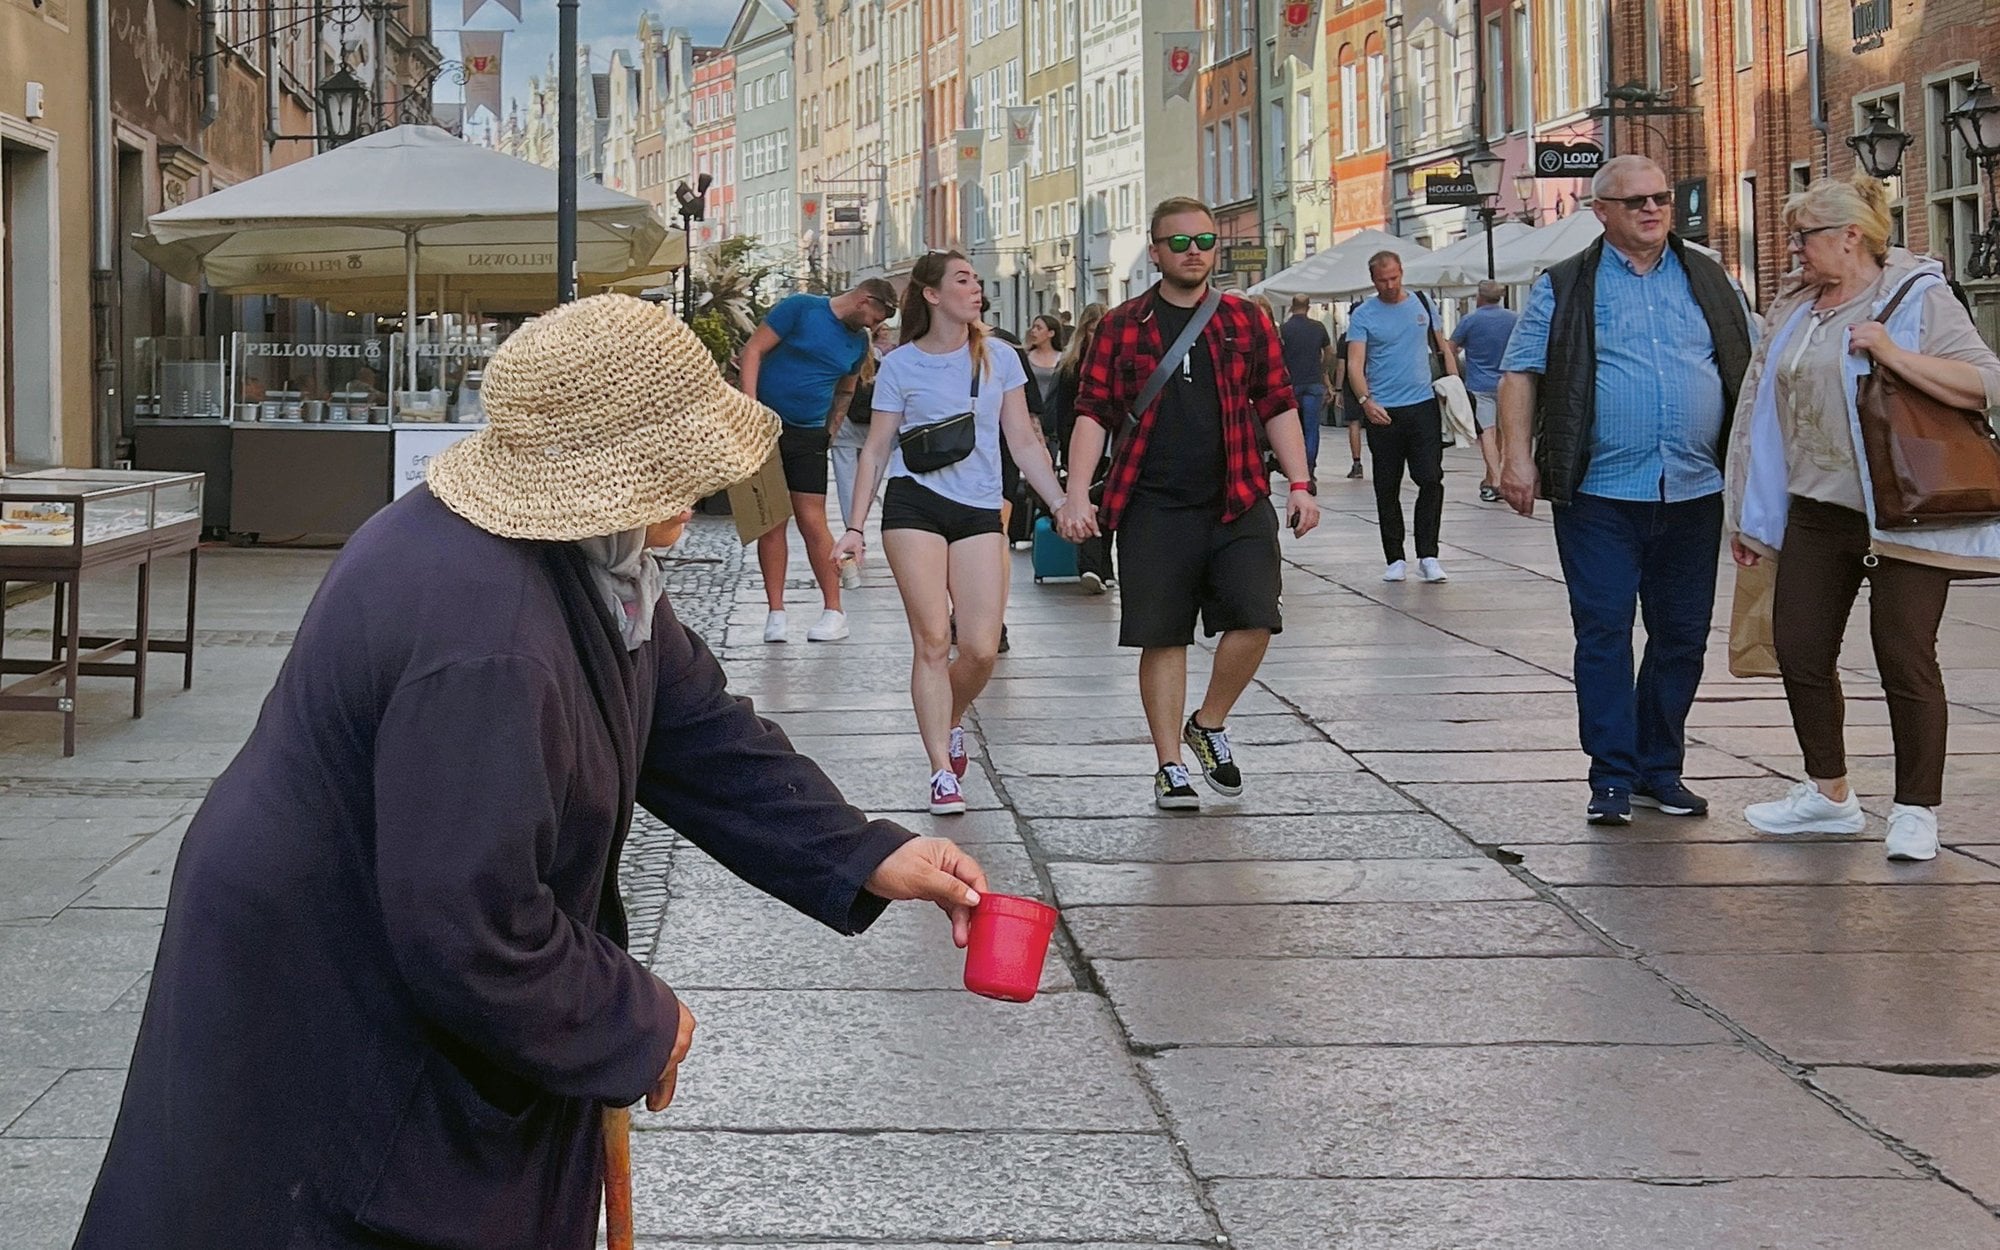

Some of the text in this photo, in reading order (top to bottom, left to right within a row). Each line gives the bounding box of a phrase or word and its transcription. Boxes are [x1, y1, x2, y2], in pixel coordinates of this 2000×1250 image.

[1563, 152, 1599, 163] LODY
[1428, 184, 1475, 194] HOKKAID
[246, 343, 361, 358] PELLOWSKI
